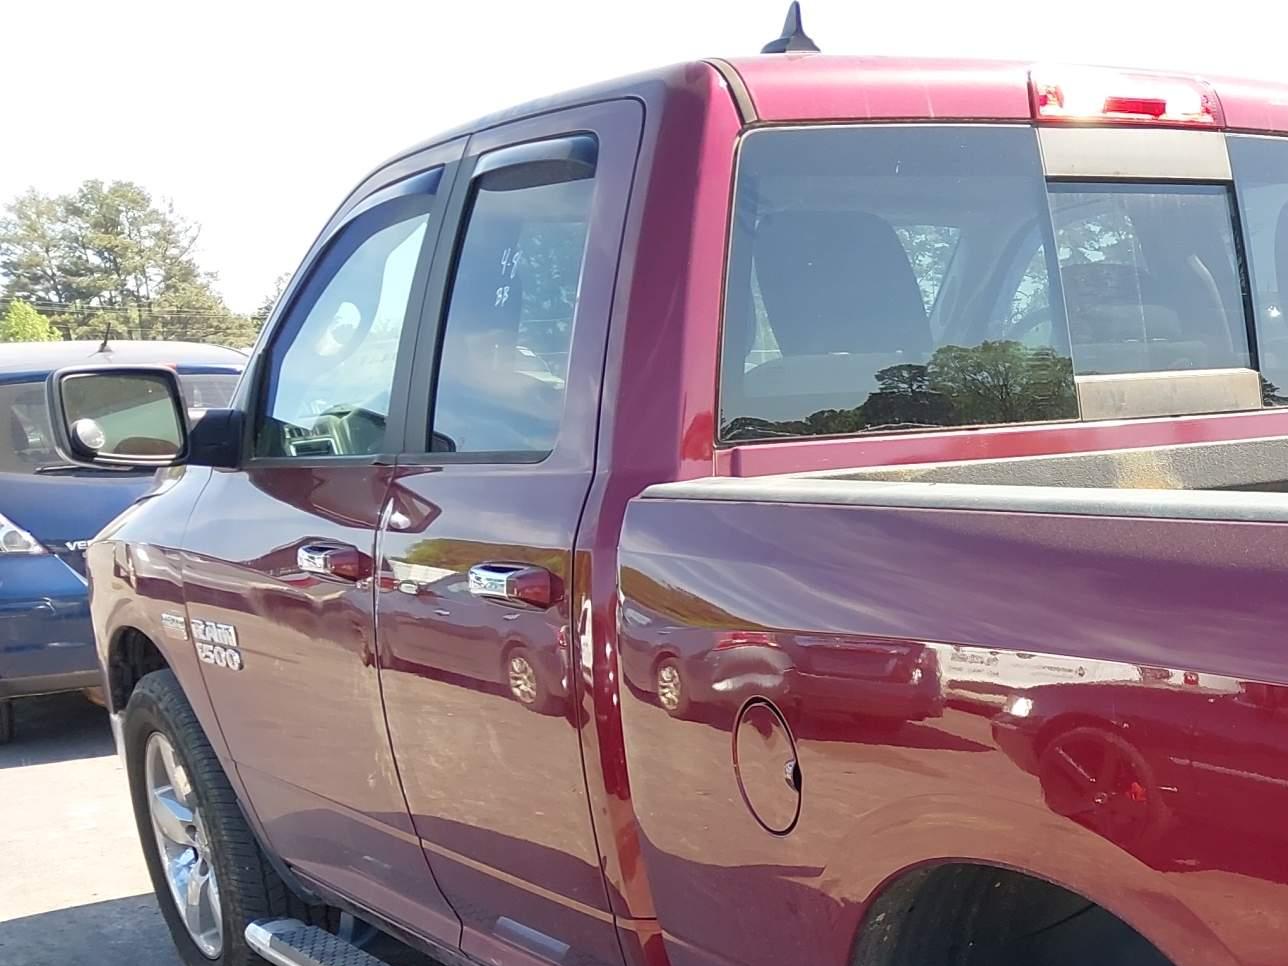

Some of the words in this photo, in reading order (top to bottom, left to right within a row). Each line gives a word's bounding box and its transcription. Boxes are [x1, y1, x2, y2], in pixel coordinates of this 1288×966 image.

[65, 539, 89, 551] VE
[190, 618, 238, 647] RAM
[195, 641, 241, 672] 1500
